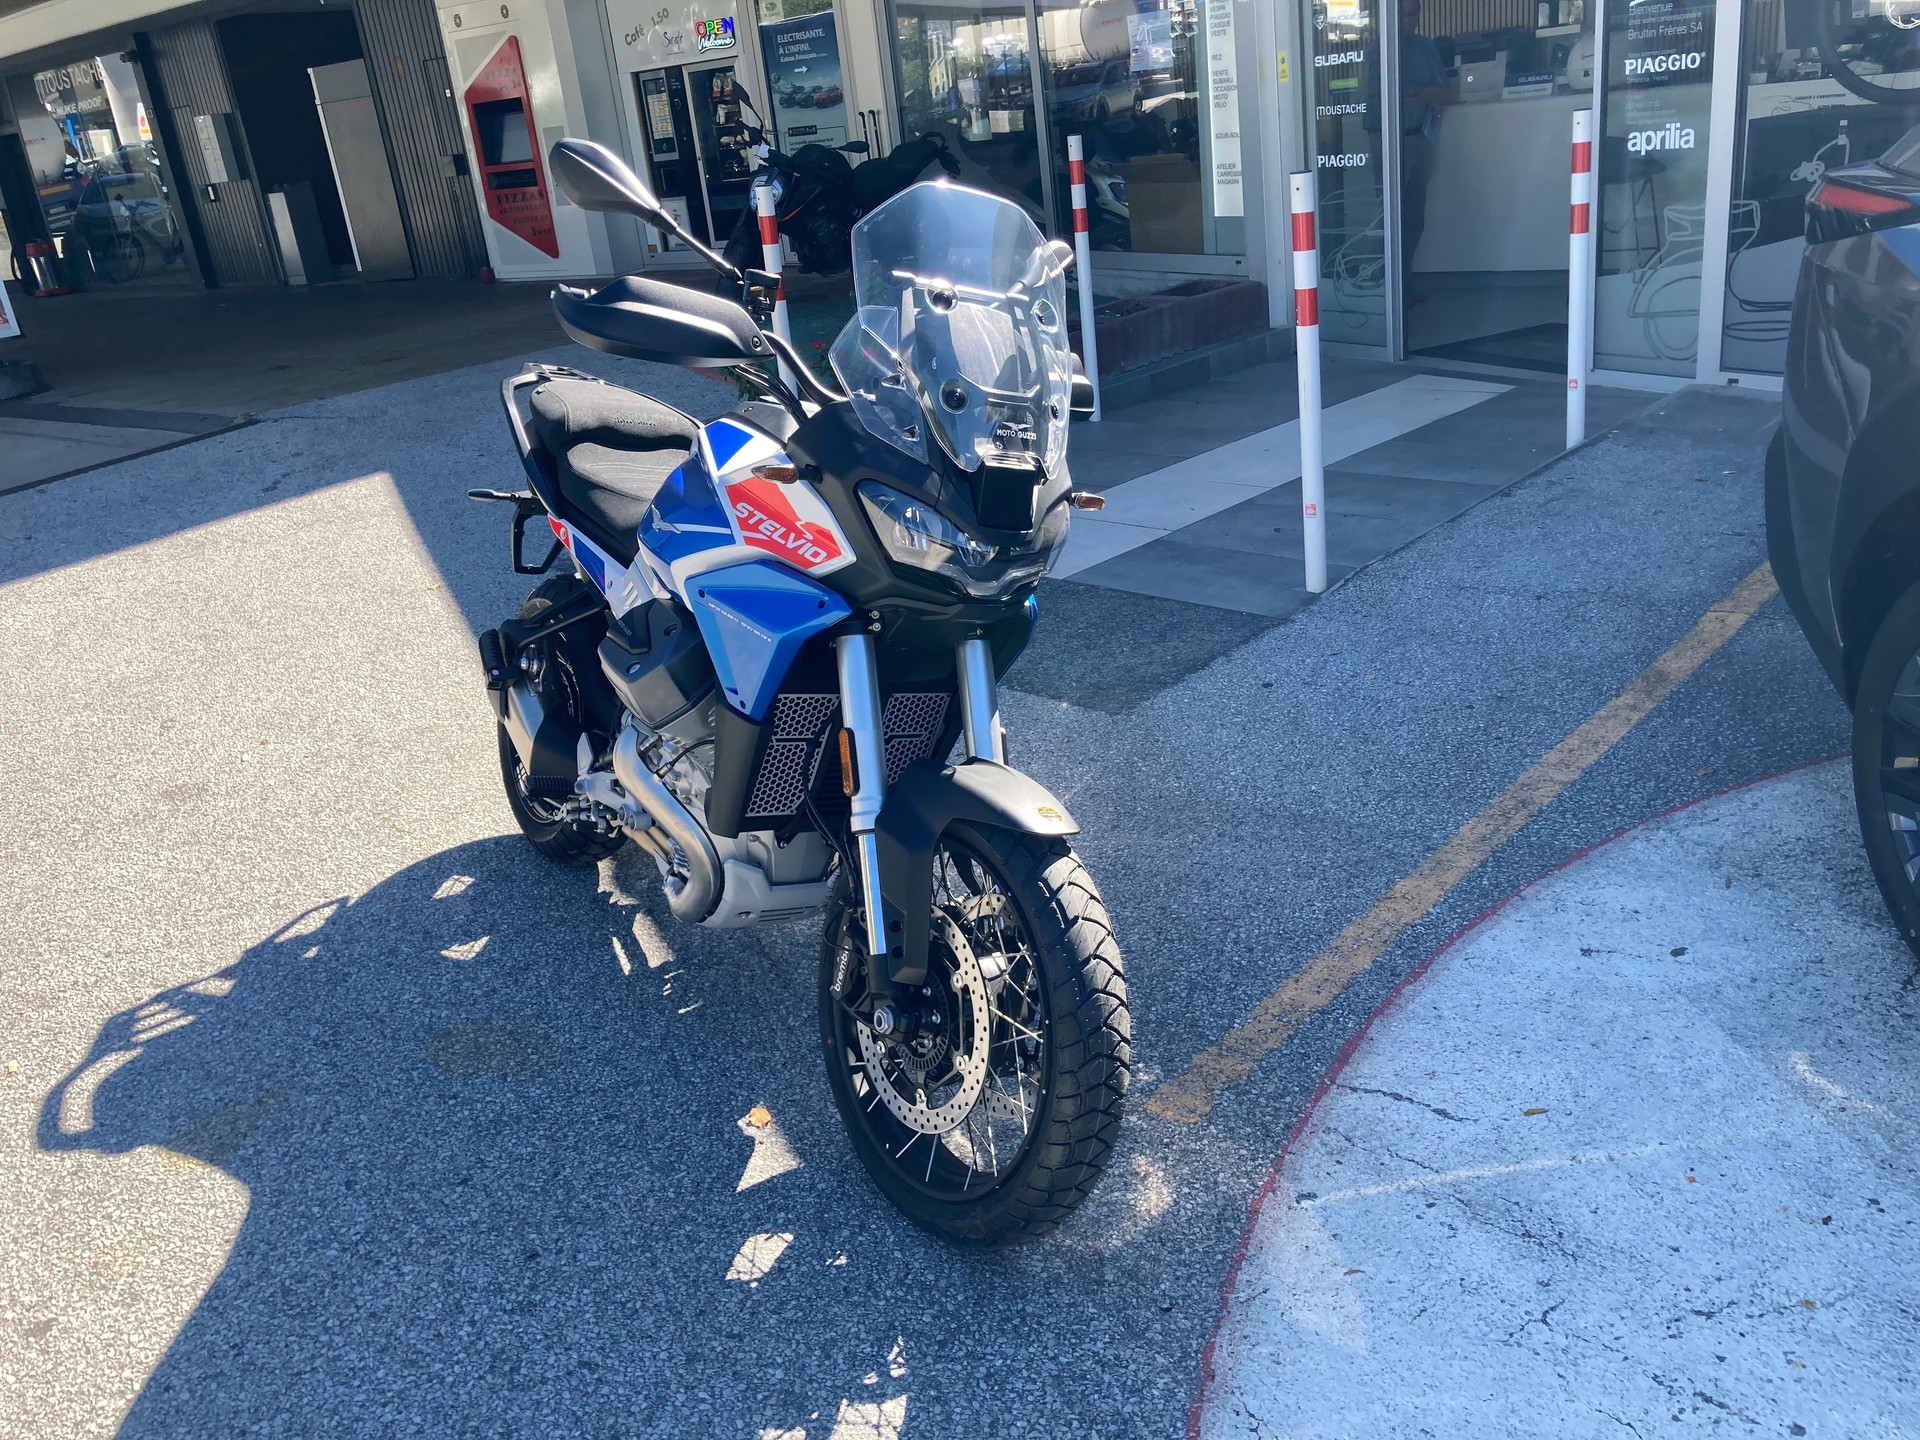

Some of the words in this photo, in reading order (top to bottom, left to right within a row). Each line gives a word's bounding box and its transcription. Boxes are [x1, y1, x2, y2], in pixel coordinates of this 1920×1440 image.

[1210, 4, 1226, 12] VESPA
[1210, 12, 1231, 20] PIAGGIO
[1629, 2, 1673, 16] Bienvenue
[624, 24, 645, 46] Café
[651, 8, 669, 27] 1.50
[695, 16, 735, 37] OPEN
[1210, 20, 1231, 29] CASQUE
[1628, 29, 1657, 40] Bruttin
[1659, 25, 1687, 37] Frères
[1690, 21, 1703, 33] SA
[1211, 29, 1228, 37] VESTE
[698, 34, 735, 54] Welcome
[1314, 50, 1364, 67] SUBARU
[1624, 52, 1701, 75] PIAGGIO
[1213, 69, 1229, 77] VENTE
[1213, 77, 1233, 85] SUBARU
[1316, 103, 1367, 120] MOUSTACHE
[1627, 122, 1695, 155] aprilia
[1317, 153, 1366, 168] PIAGGIO
[496, 189, 544, 205] PIZZAS
[996, 429, 1016, 438] MOTO
[1017, 431, 1037, 440] GUZZI
[735, 502, 828, 563] STELVIO
[833, 945, 850, 992] brembo
